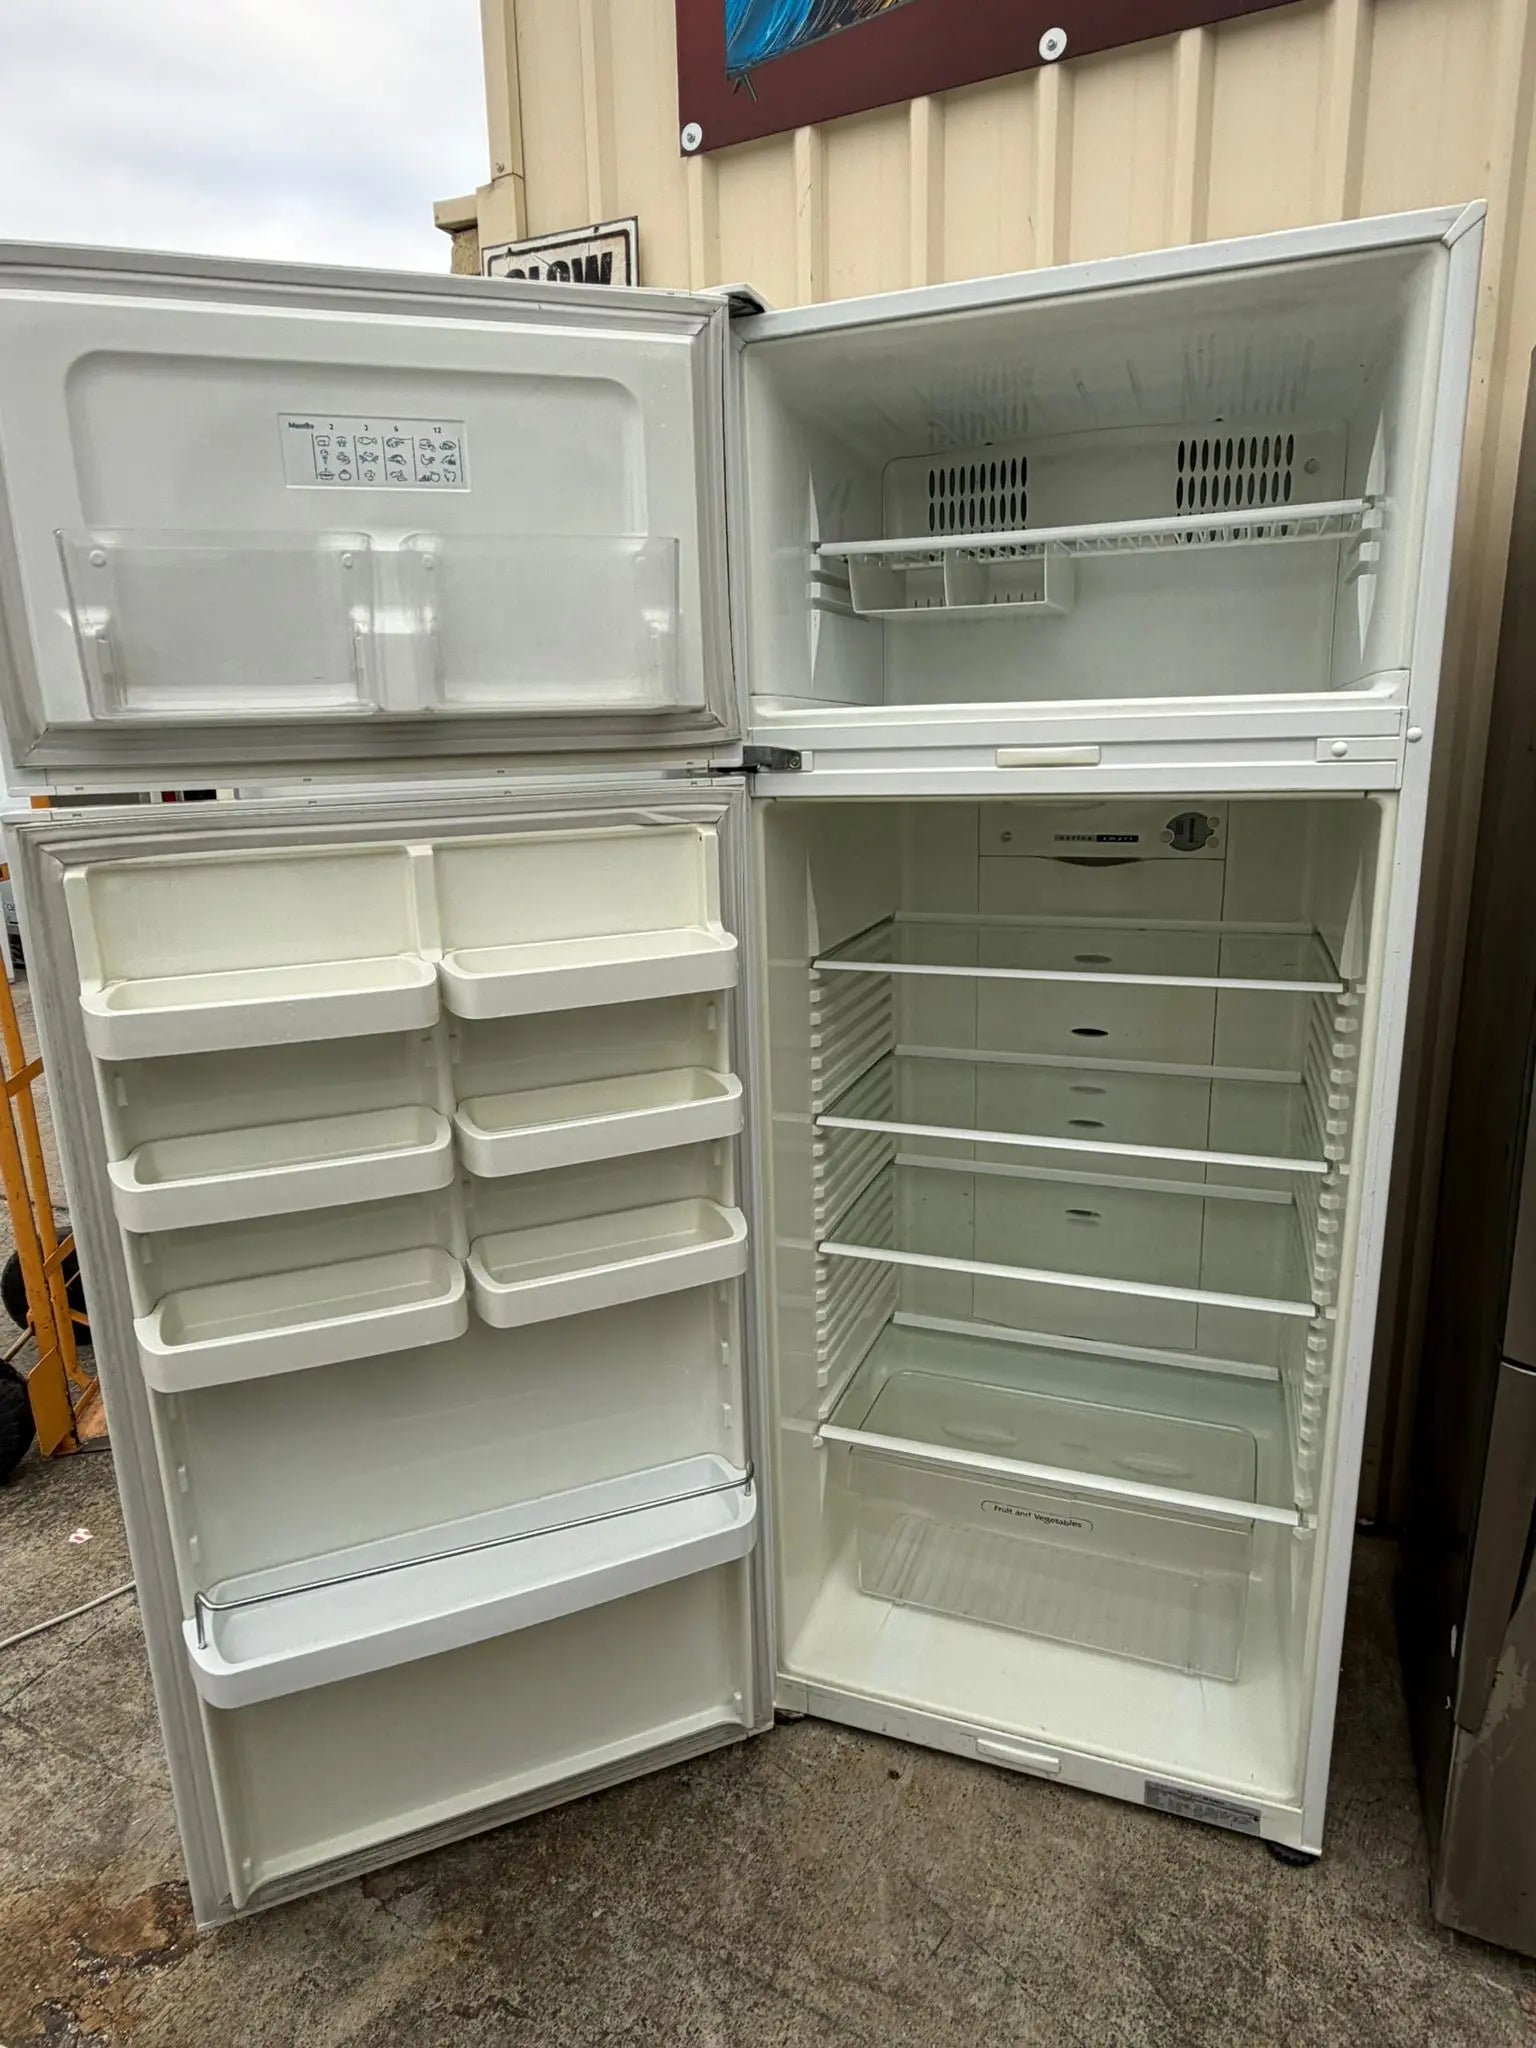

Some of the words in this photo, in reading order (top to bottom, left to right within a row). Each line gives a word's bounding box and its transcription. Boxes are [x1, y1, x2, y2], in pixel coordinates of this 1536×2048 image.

[505, 251, 613, 285] OW
[433, 426, 442, 434] 12
[994, 1505, 1012, 1515] Fruit
[1015, 1509, 1032, 1518] and
[1033, 1512, 1083, 1529] Vegetables
